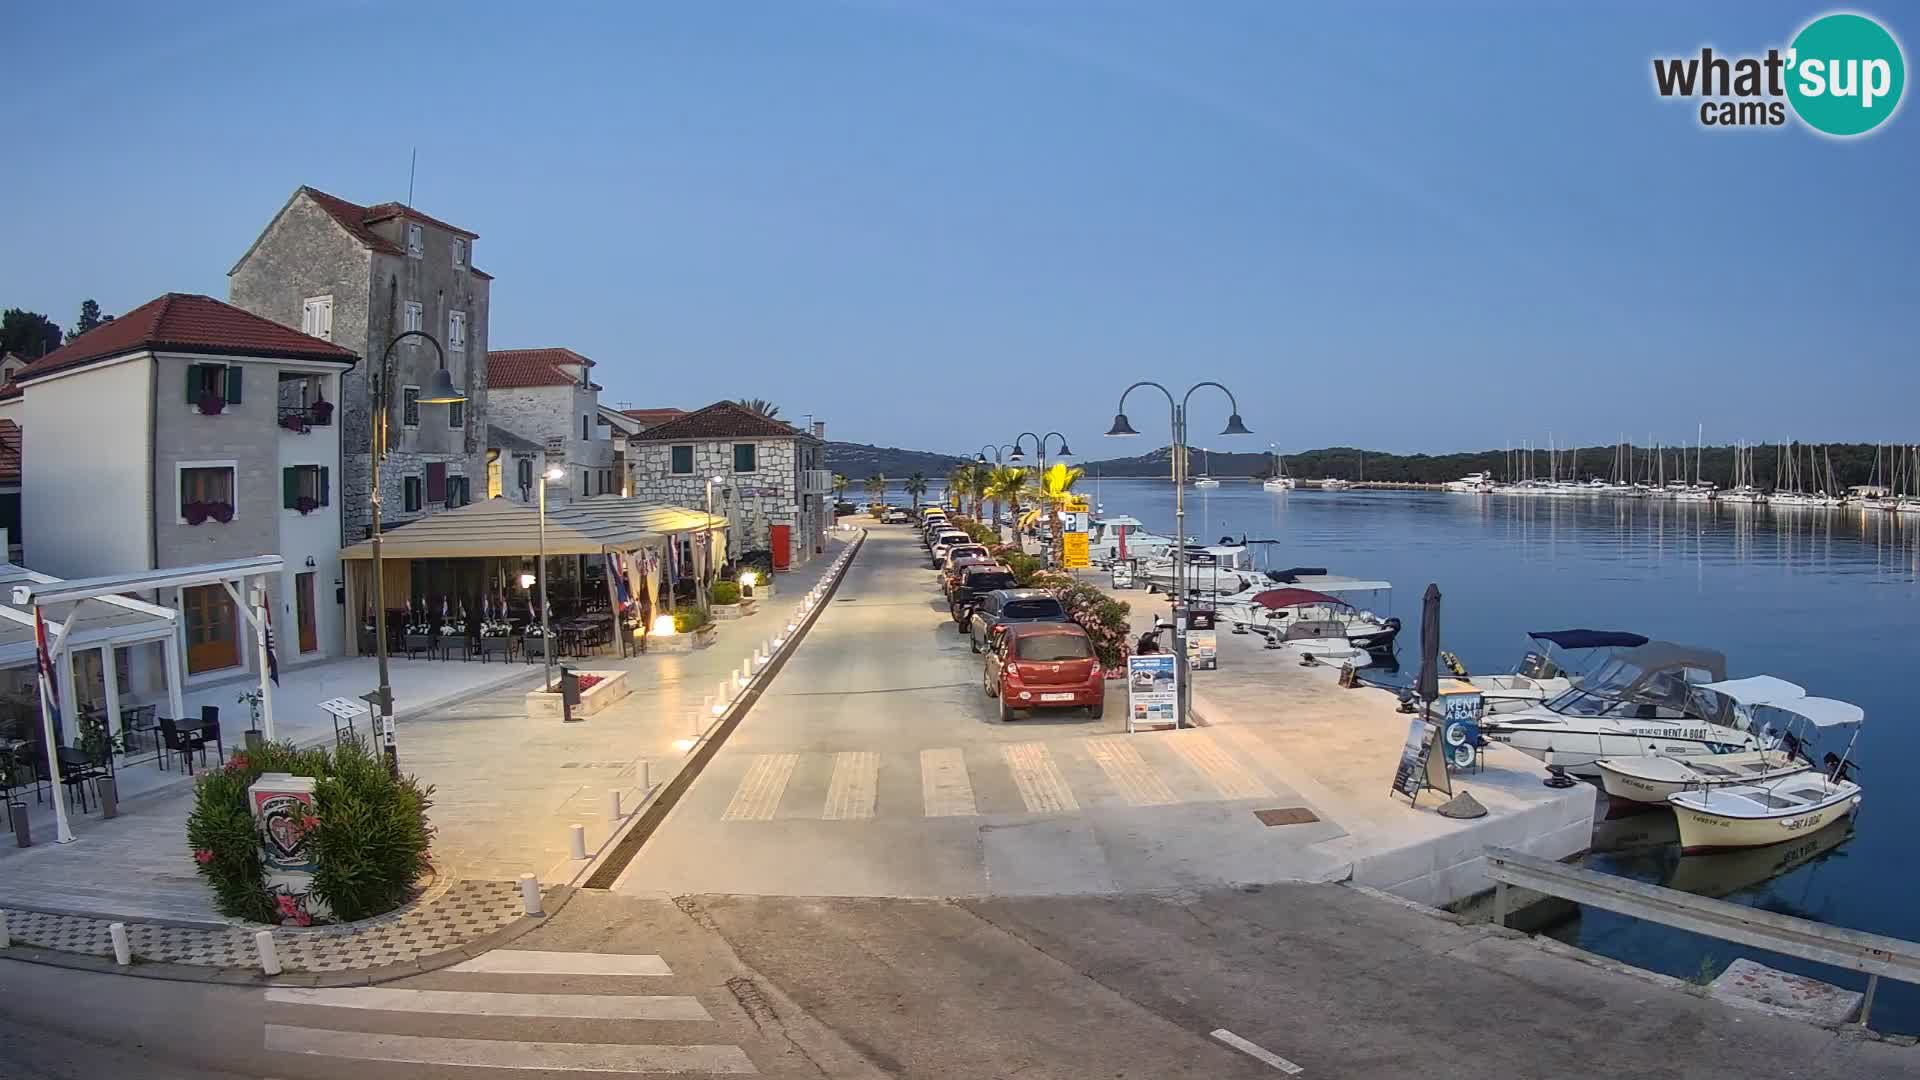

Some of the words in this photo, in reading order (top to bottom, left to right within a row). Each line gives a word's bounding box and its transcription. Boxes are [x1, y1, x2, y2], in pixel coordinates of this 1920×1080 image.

[1447, 697, 1481, 712] RENT
[1446, 710, 1453, 721] A
[1663, 728, 1682, 737] RENT
[1683, 728, 1688, 737] A
[1689, 728, 1707, 739] BOAT
